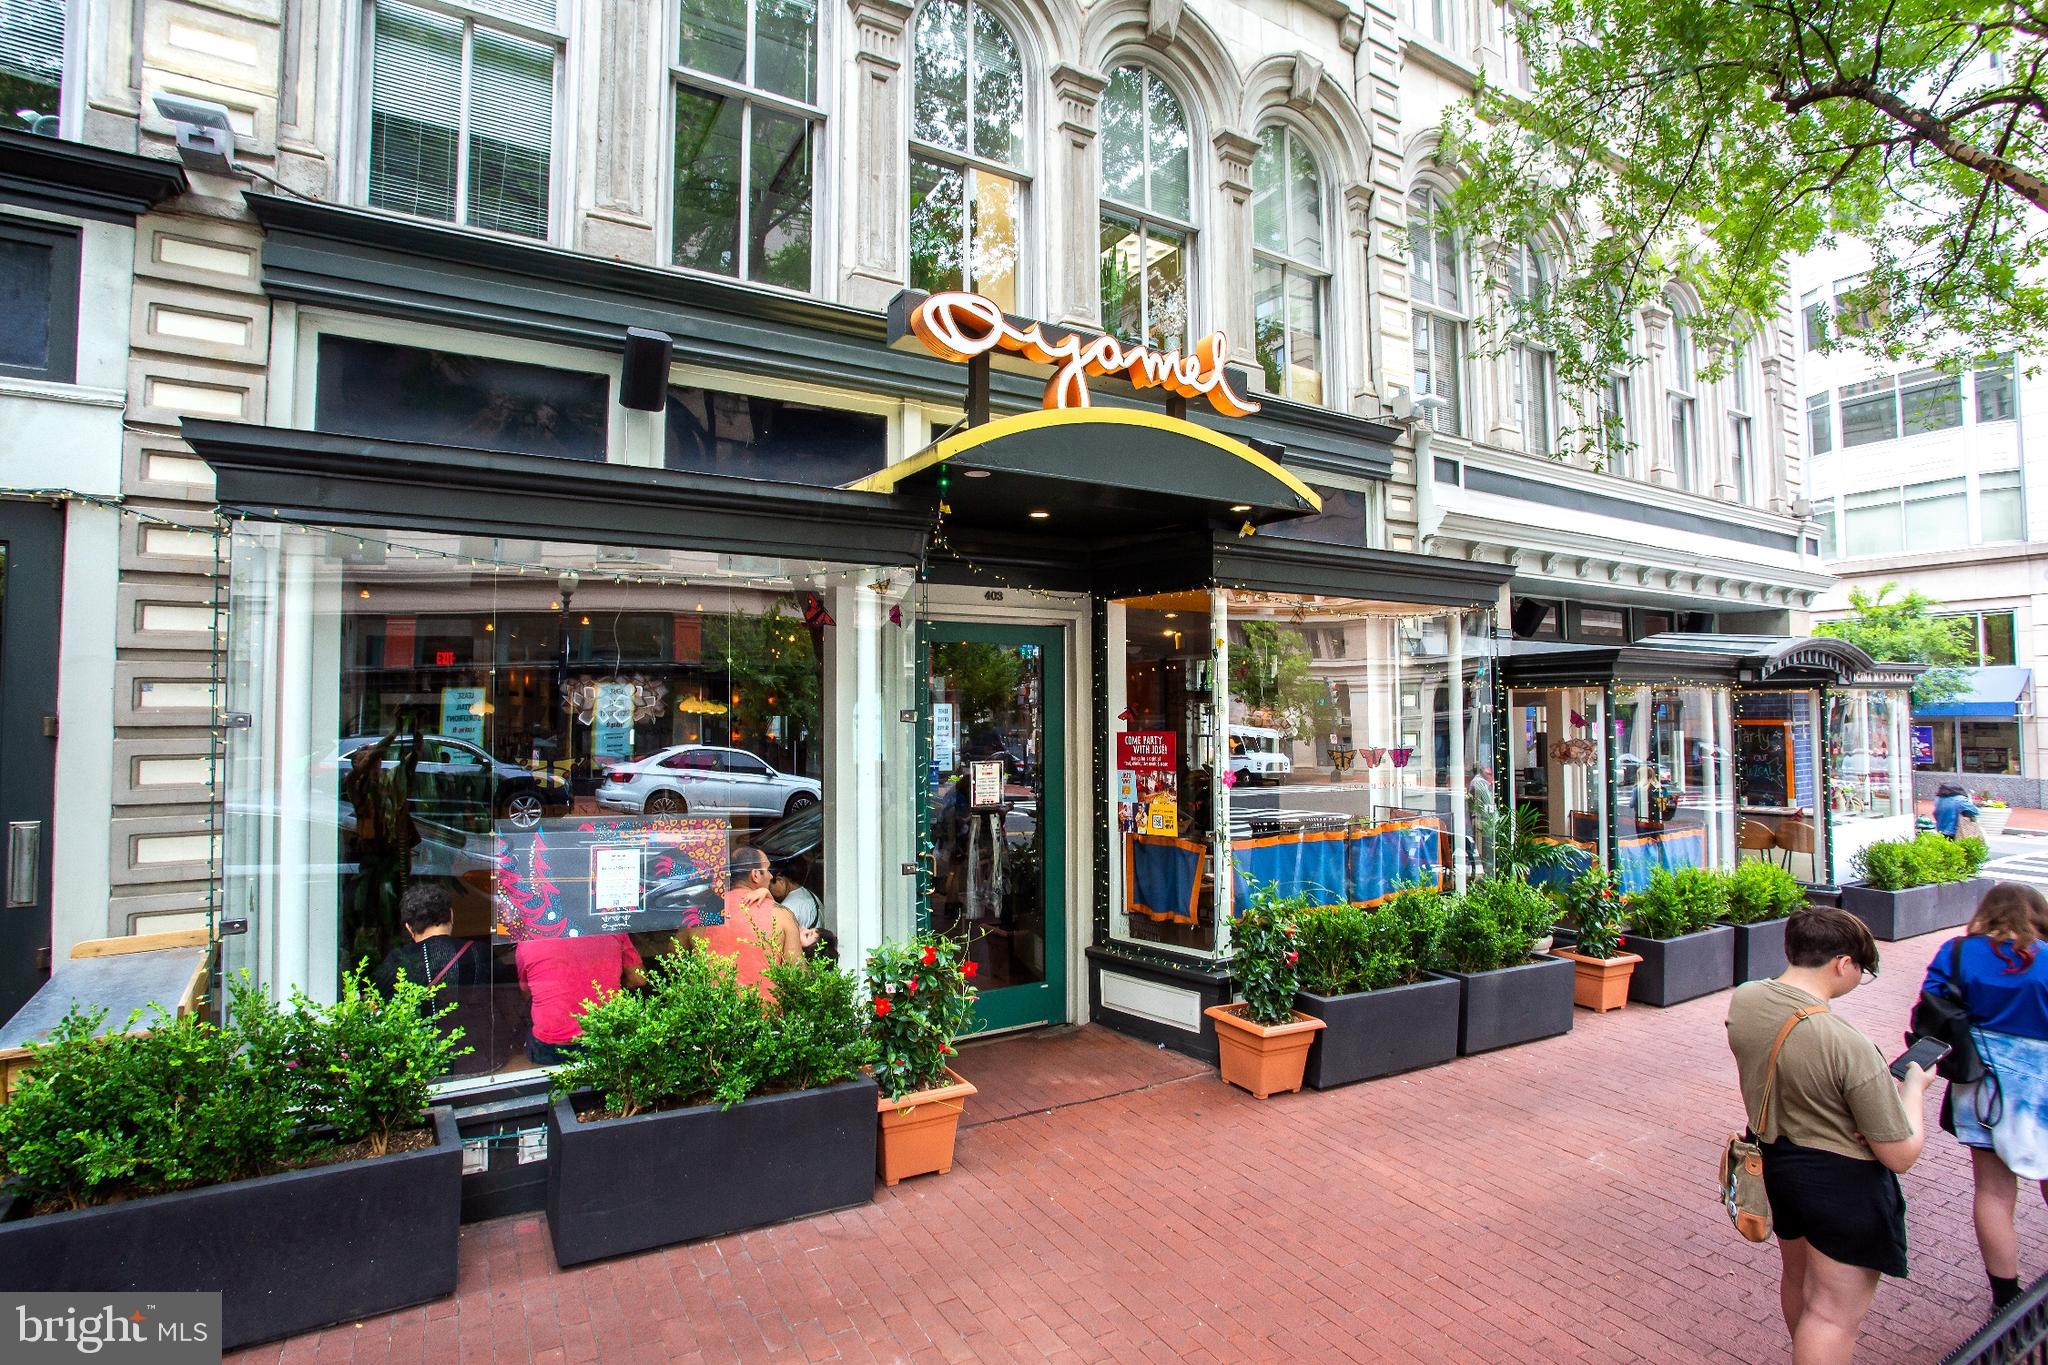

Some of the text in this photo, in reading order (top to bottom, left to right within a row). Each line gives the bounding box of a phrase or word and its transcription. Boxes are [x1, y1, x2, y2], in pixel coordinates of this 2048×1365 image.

[911, 290, 1262, 418] Oyamel
[984, 590, 1004, 601] 403
[436, 651, 453, 665] EXIT
[1124, 735, 1163, 745] COME PARTY
[1132, 744, 1150, 754] WITH
